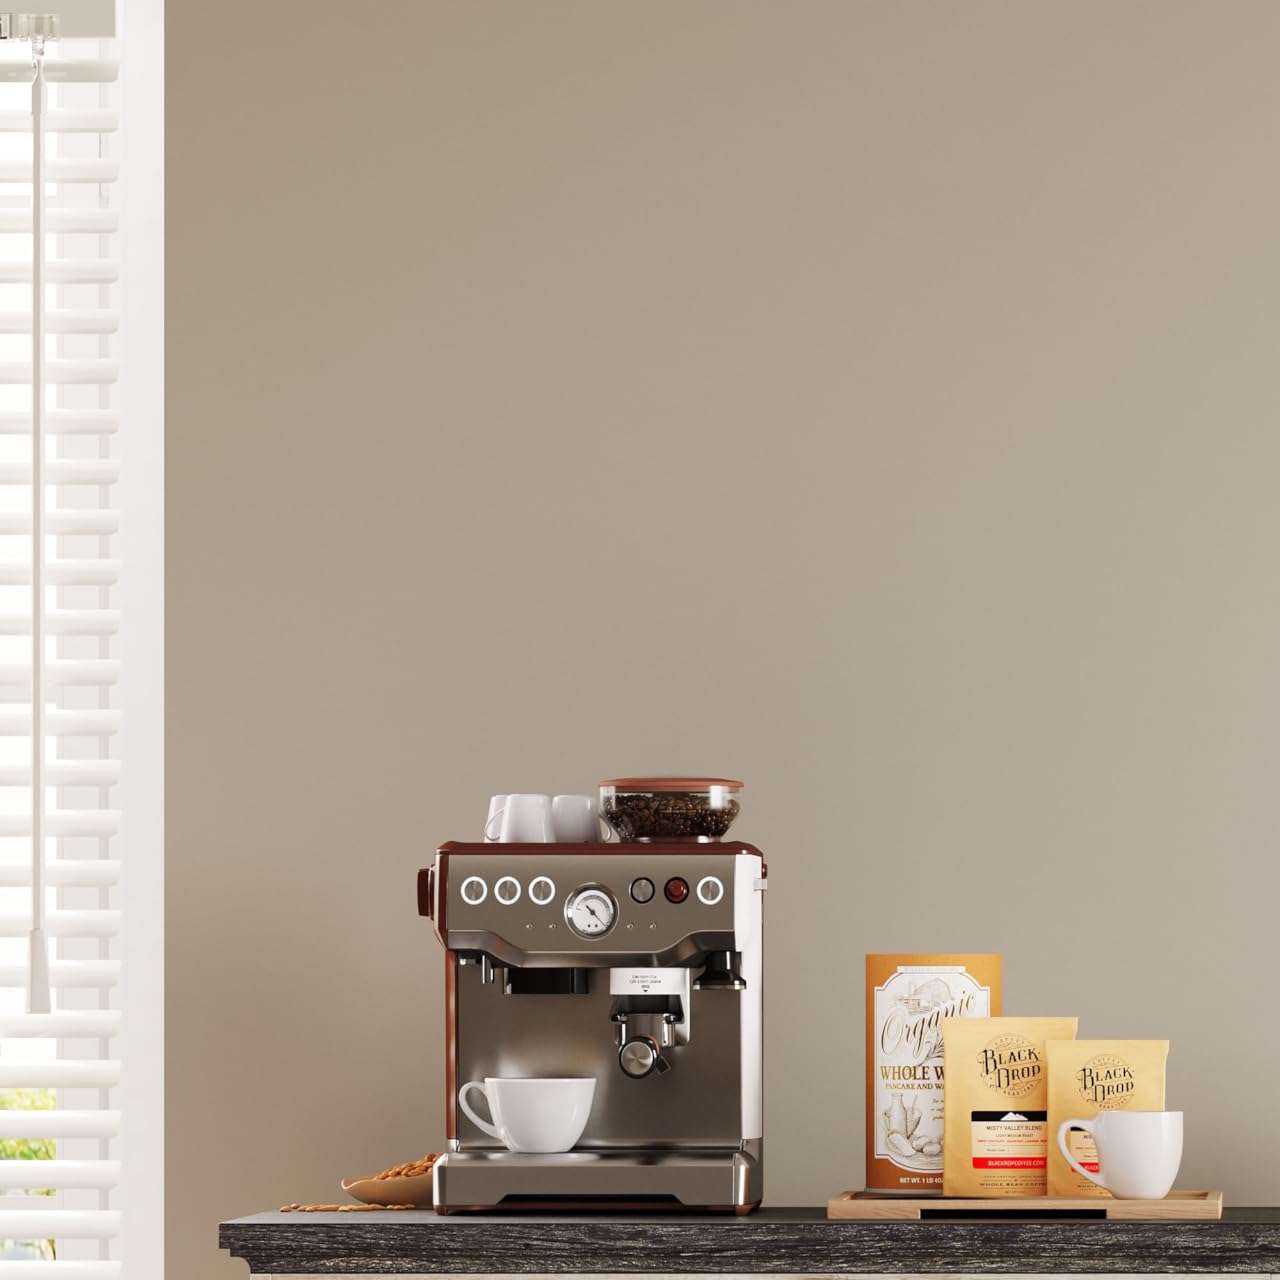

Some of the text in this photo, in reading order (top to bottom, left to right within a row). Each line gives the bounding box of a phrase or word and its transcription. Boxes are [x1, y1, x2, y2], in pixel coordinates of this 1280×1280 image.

[881, 989, 976, 1058] Organic
[880, 1066, 930, 1080] WHOLE
[977, 1047, 1040, 1076] BLACK
[989, 1064, 1041, 1091] DROP
[1076, 1066, 1133, 1091] BLACK
[1087, 1081, 1135, 1102] DROP
